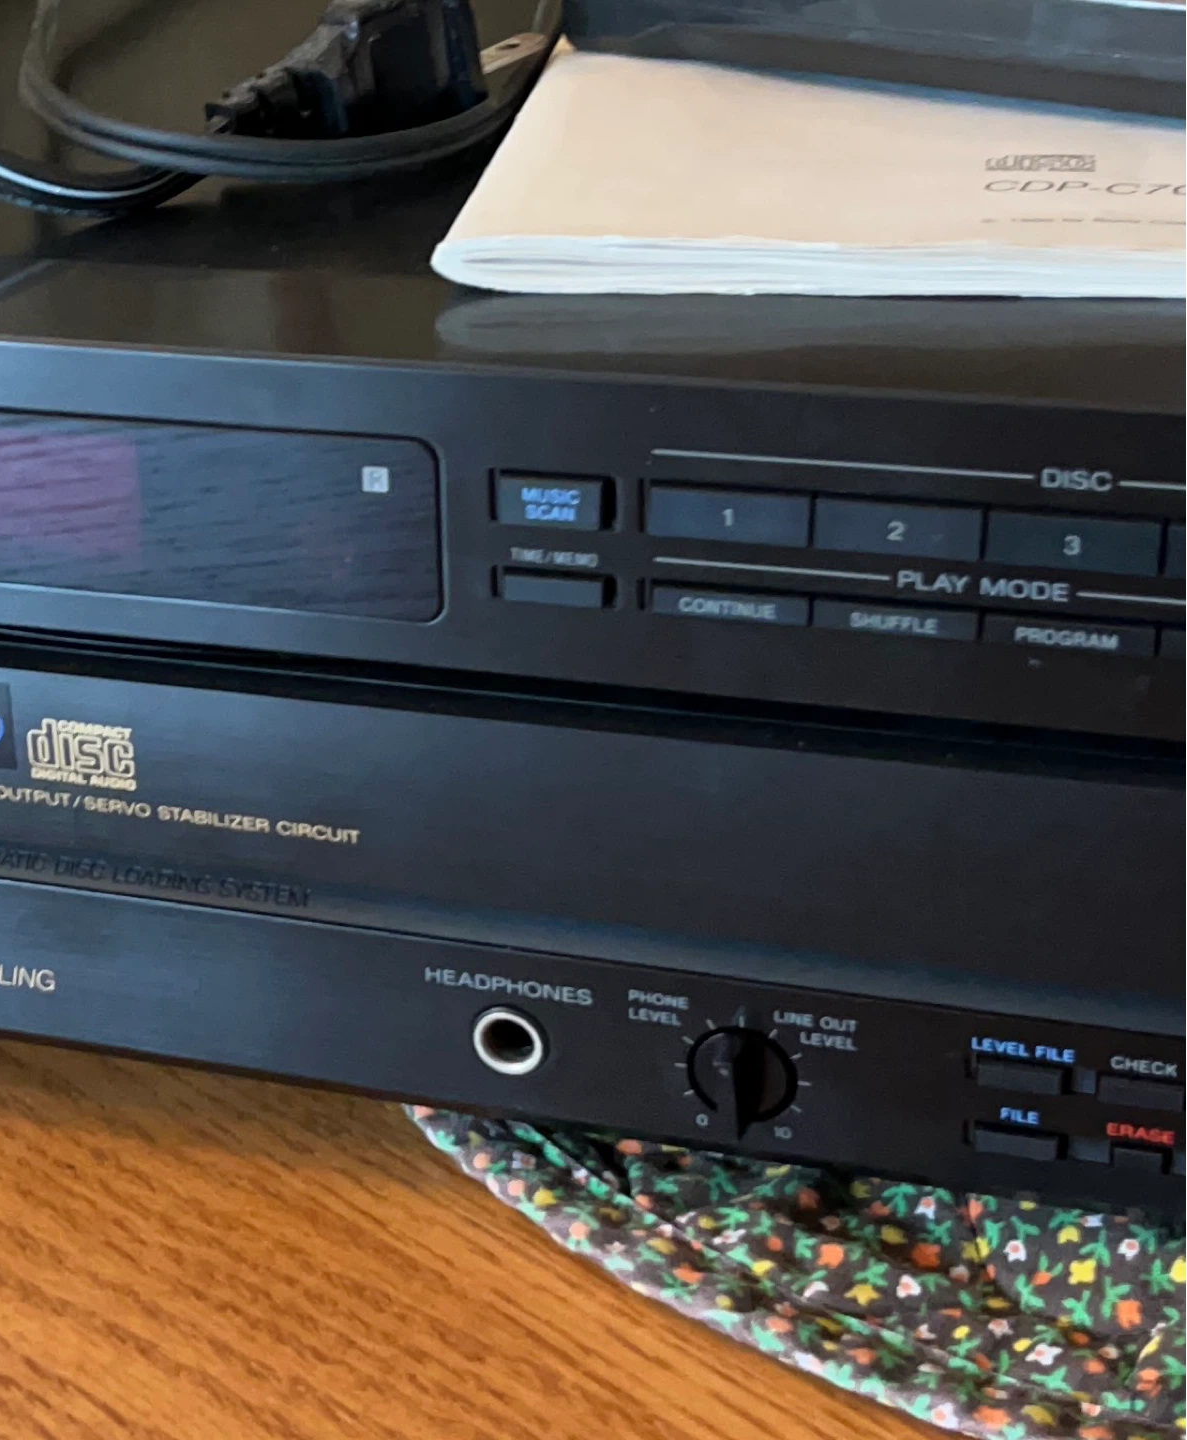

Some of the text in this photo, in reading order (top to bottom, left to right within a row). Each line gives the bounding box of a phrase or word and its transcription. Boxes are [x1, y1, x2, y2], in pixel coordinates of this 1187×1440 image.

[1039, 467, 1113, 493] DISC
[521, 486, 582, 506] MUSIC
[524, 504, 577, 523] SCAN
[722, 507, 735, 527] 1
[886, 520, 905, 542] 2
[1063, 535, 1082, 556] 3
[897, 569, 1071, 602] PLAY MODE
[678, 596, 778, 621] CONTINUE
[849, 611, 940, 636] SHUFFLE
[1015, 626, 1120, 651] PROGRAM
[58, 719, 132, 740] COMPACT
[27, 718, 135, 778] disc
[31, 767, 137, 792] DIGITAL AUDIO
[157, 806, 270, 833] STABILIZER
[276, 820, 361, 845] CIRCUIT
[54, 858, 107, 880] DISC
[112, 865, 212, 894] LOADING
[219, 878, 312, 908] SYSTEM
[424, 966, 593, 1006] HEADPHONES
[627, 989, 689, 1010] PHONE
[627, 1007, 682, 1027] LEVEL
[773, 1009, 858, 1033] LINE OUT
[800, 1030, 858, 1051] LEVEL
[971, 1036, 1077, 1063] LEVEL FILE
[1110, 1055, 1178, 1078] CHECK
[695, 1113, 709, 1127] 0
[1000, 1106, 1040, 1125] FILE
[773, 1125, 793, 1140] 10
[1106, 1122, 1176, 1146] ERASE
